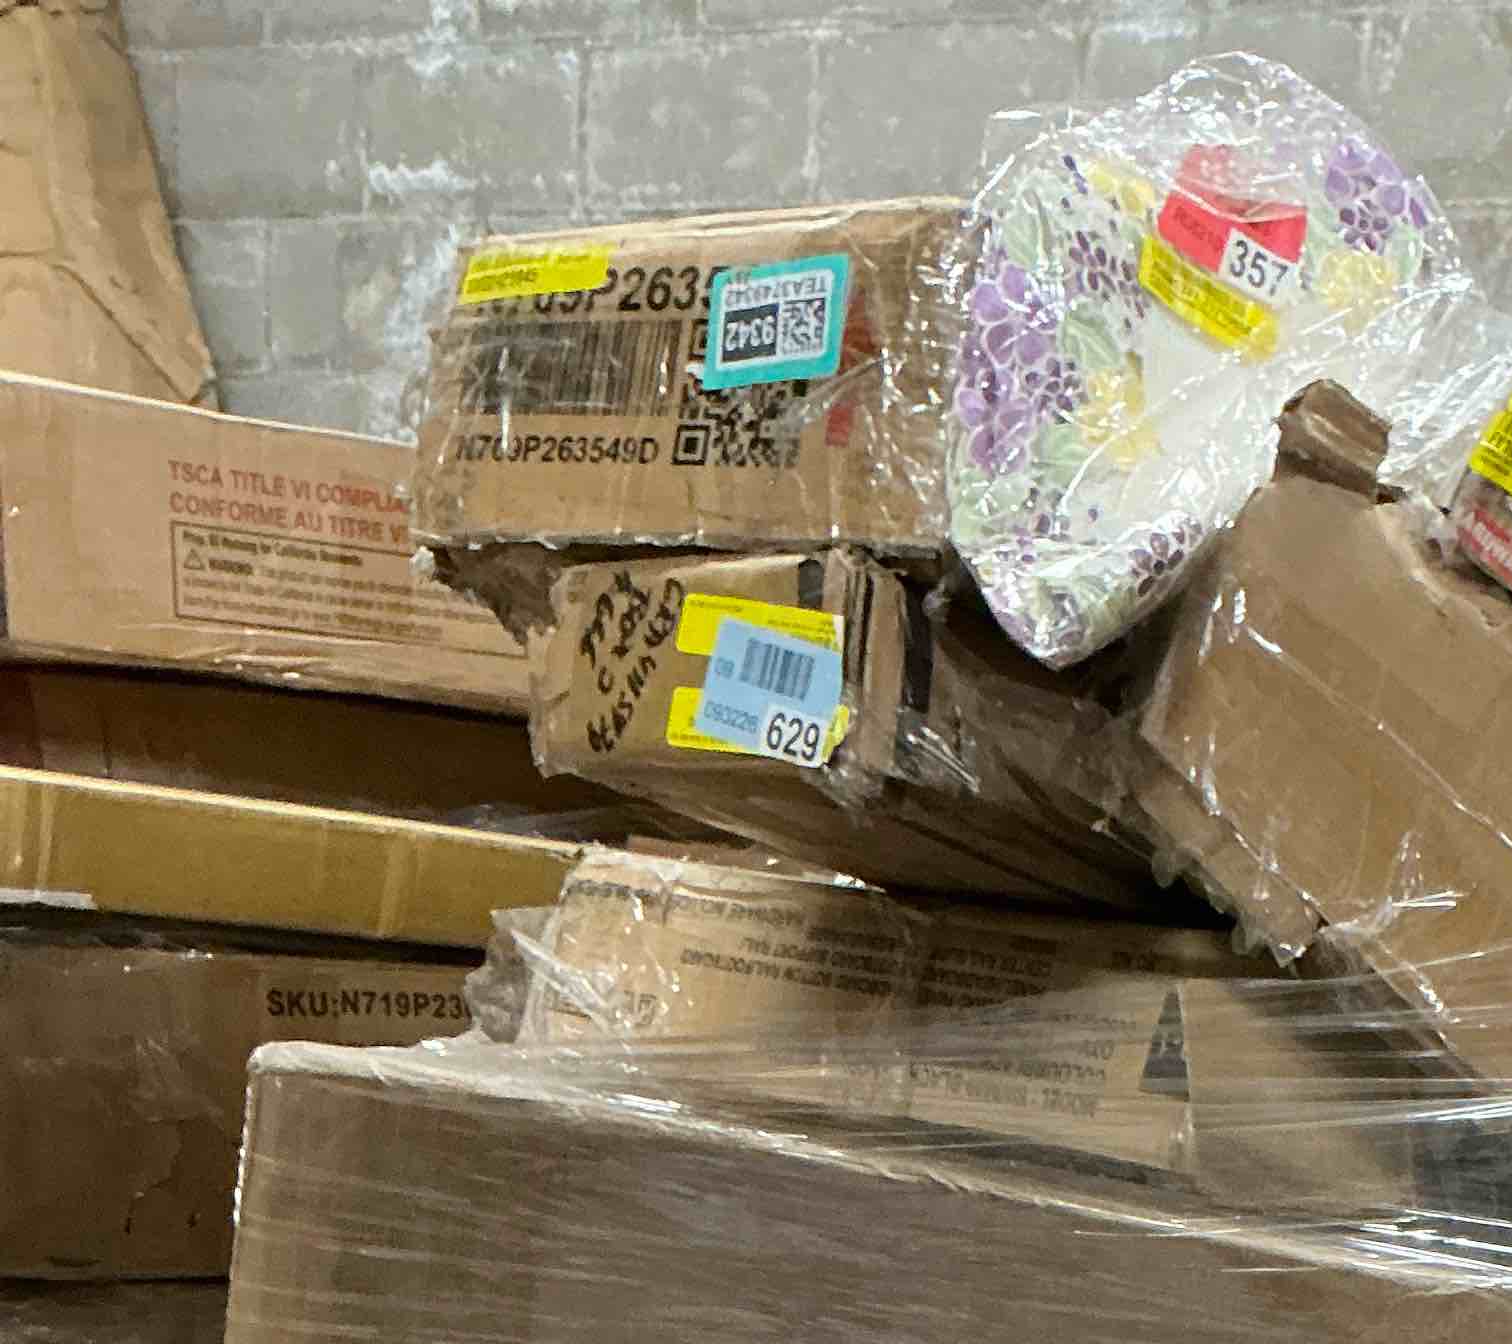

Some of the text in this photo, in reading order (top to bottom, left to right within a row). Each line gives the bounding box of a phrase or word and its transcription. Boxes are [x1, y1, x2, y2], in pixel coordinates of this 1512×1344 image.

[1227, 237, 1290, 297] 357
[725, 315, 775, 352] 9342
[168, 459, 224, 485] TSCA
[229, 469, 284, 498] TITLE
[291, 479, 311, 500] VI
[169, 490, 289, 529] CONFORME
[294, 509, 323, 532] AU
[328, 514, 385, 543] TITRE
[766, 711, 821, 762] 629
[266, 988, 473, 1020] SKU:N719P23
